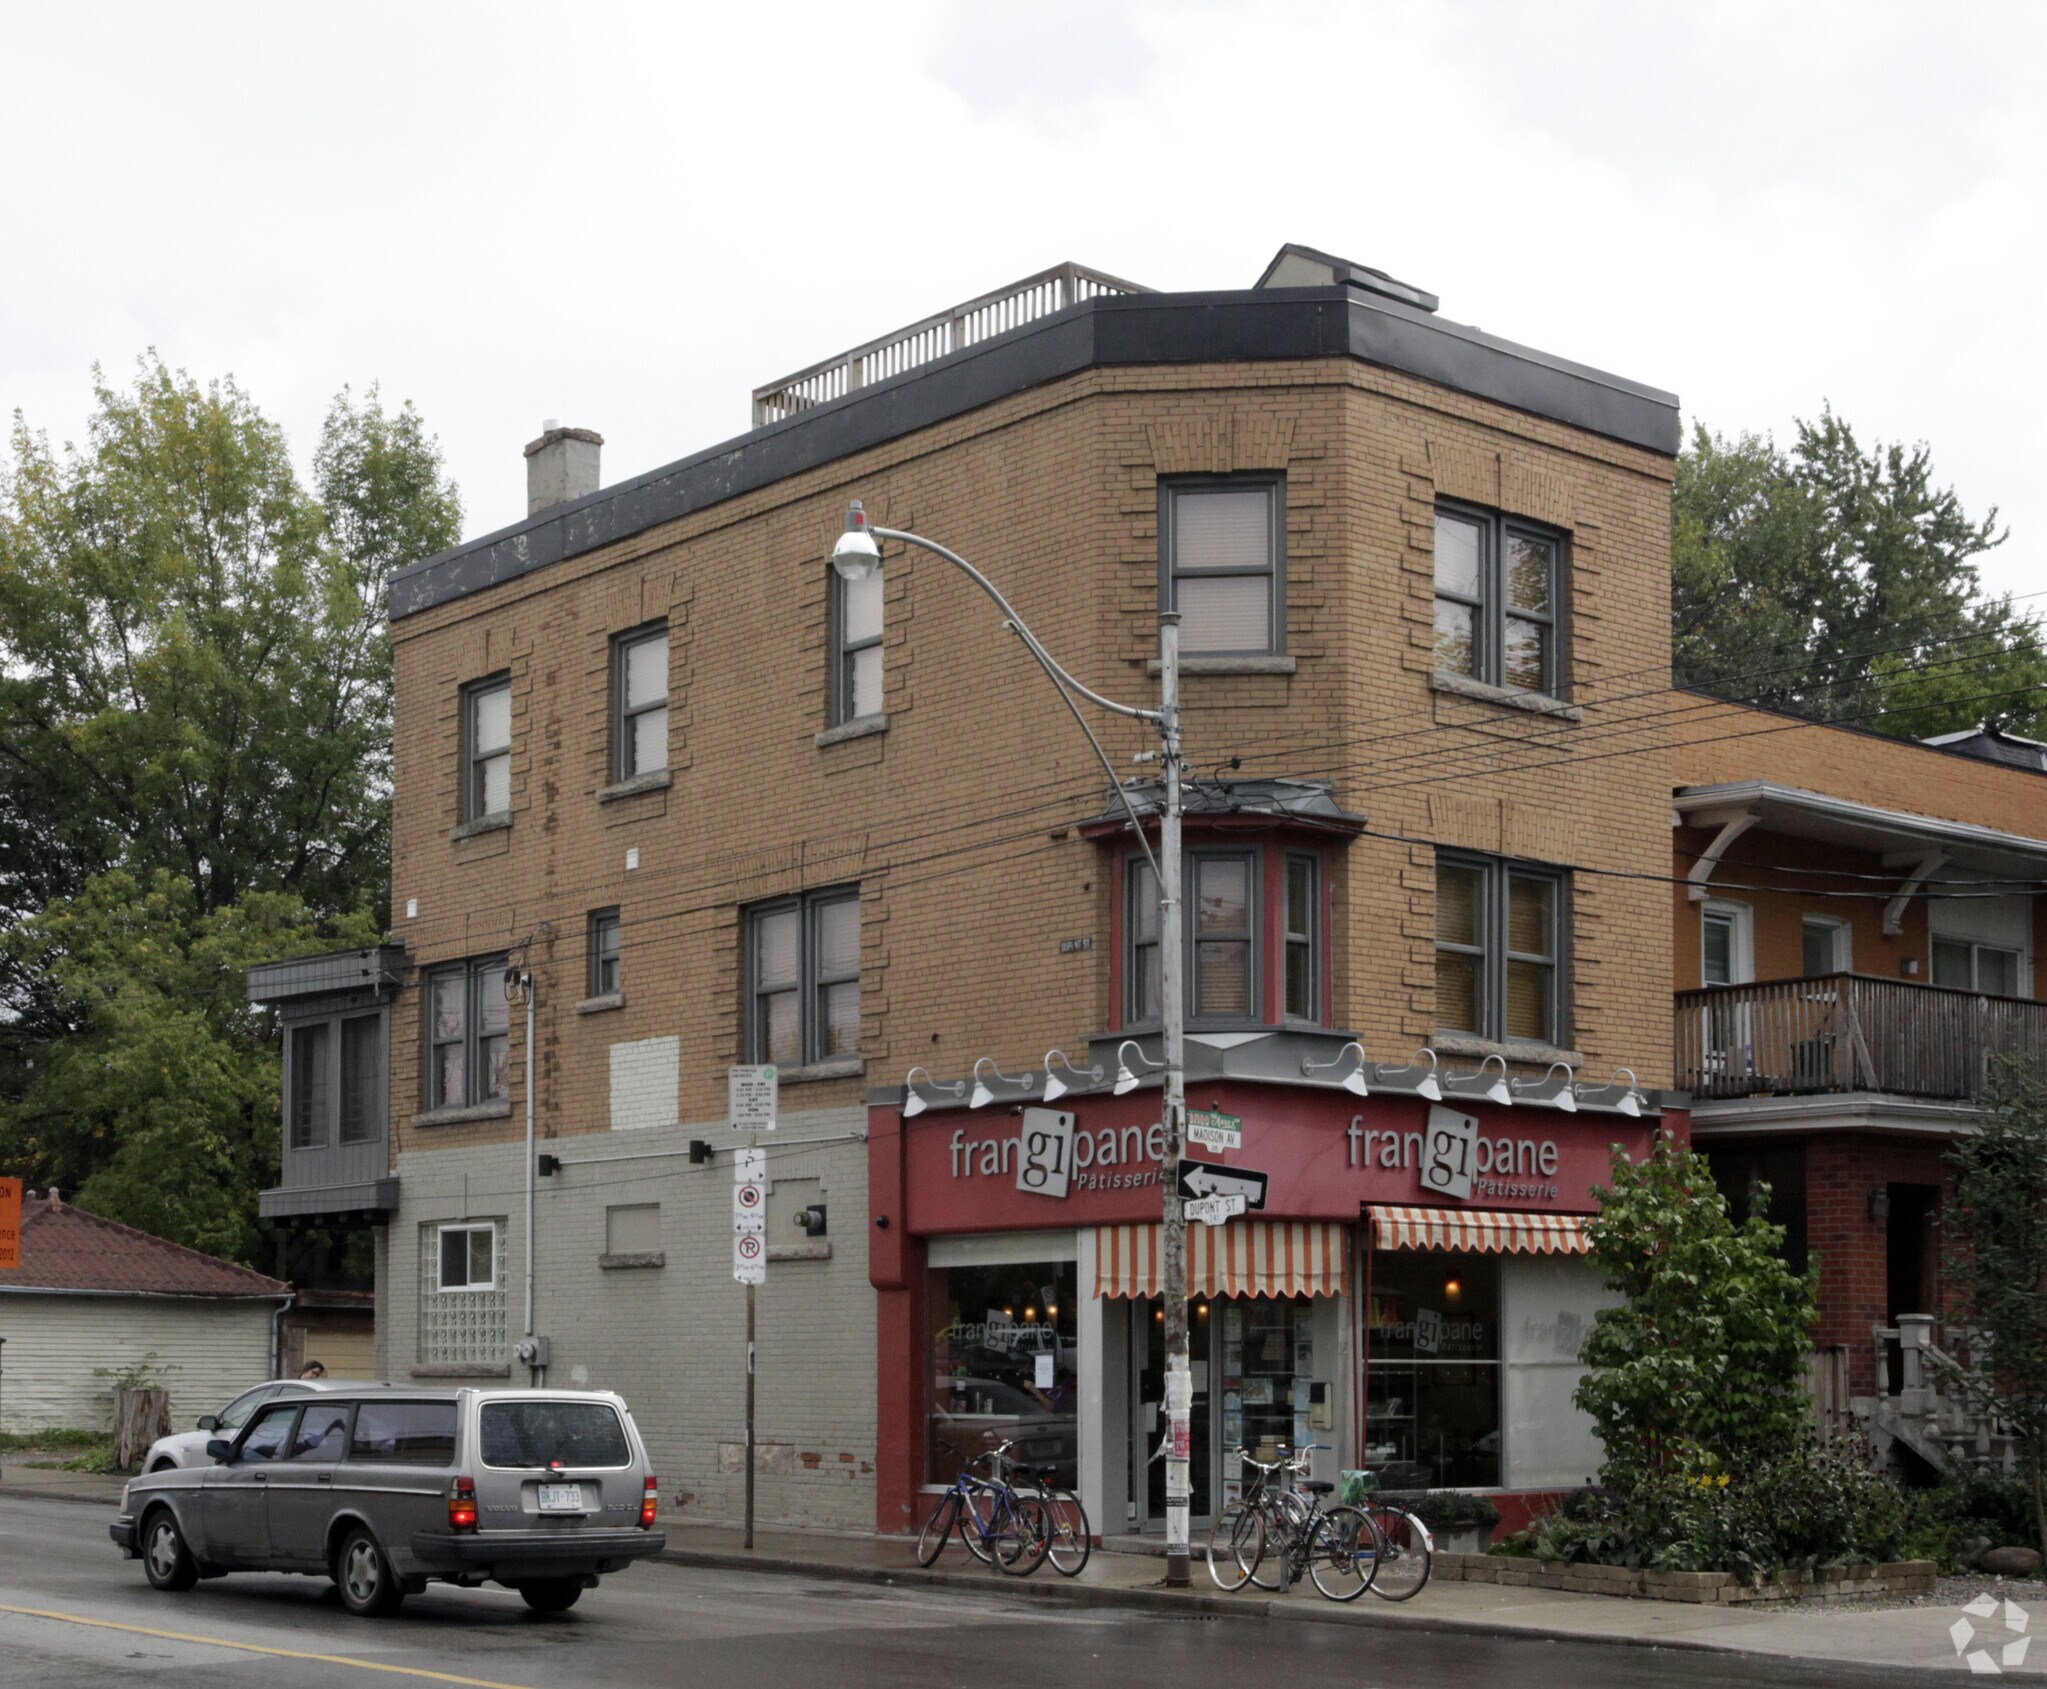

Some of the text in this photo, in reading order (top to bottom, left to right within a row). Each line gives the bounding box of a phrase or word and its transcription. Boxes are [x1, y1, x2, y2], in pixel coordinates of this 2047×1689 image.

[950, 1115, 1164, 1188] frangipane
[1193, 1127, 1224, 1144] MADISON
[1347, 1115, 1559, 1187] frangipane
[1189, 1198, 1236, 1216] DUPONT ST
